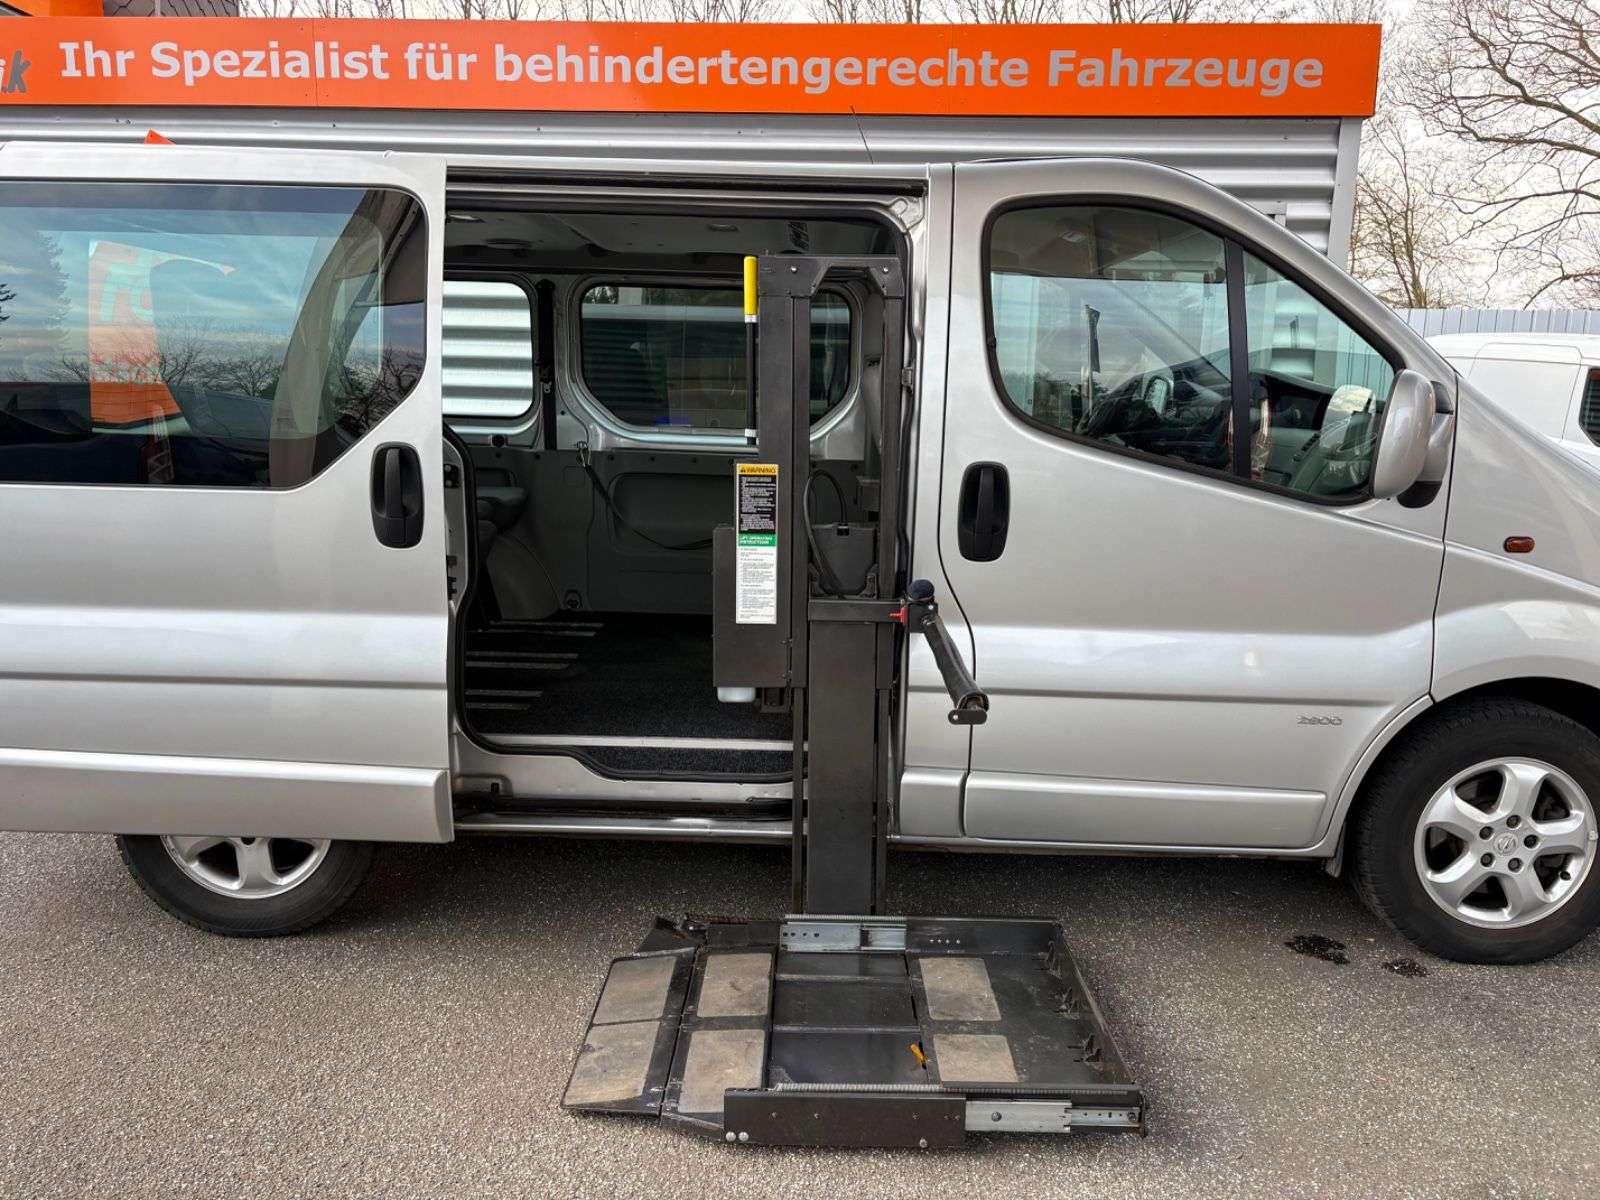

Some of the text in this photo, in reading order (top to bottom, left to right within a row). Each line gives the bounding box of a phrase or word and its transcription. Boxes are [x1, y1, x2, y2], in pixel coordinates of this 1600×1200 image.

[60, 41, 1322, 97] Ihr Spezialist für behindertengerechte Fahrzeuge
[746, 466, 776, 474] WARNING
